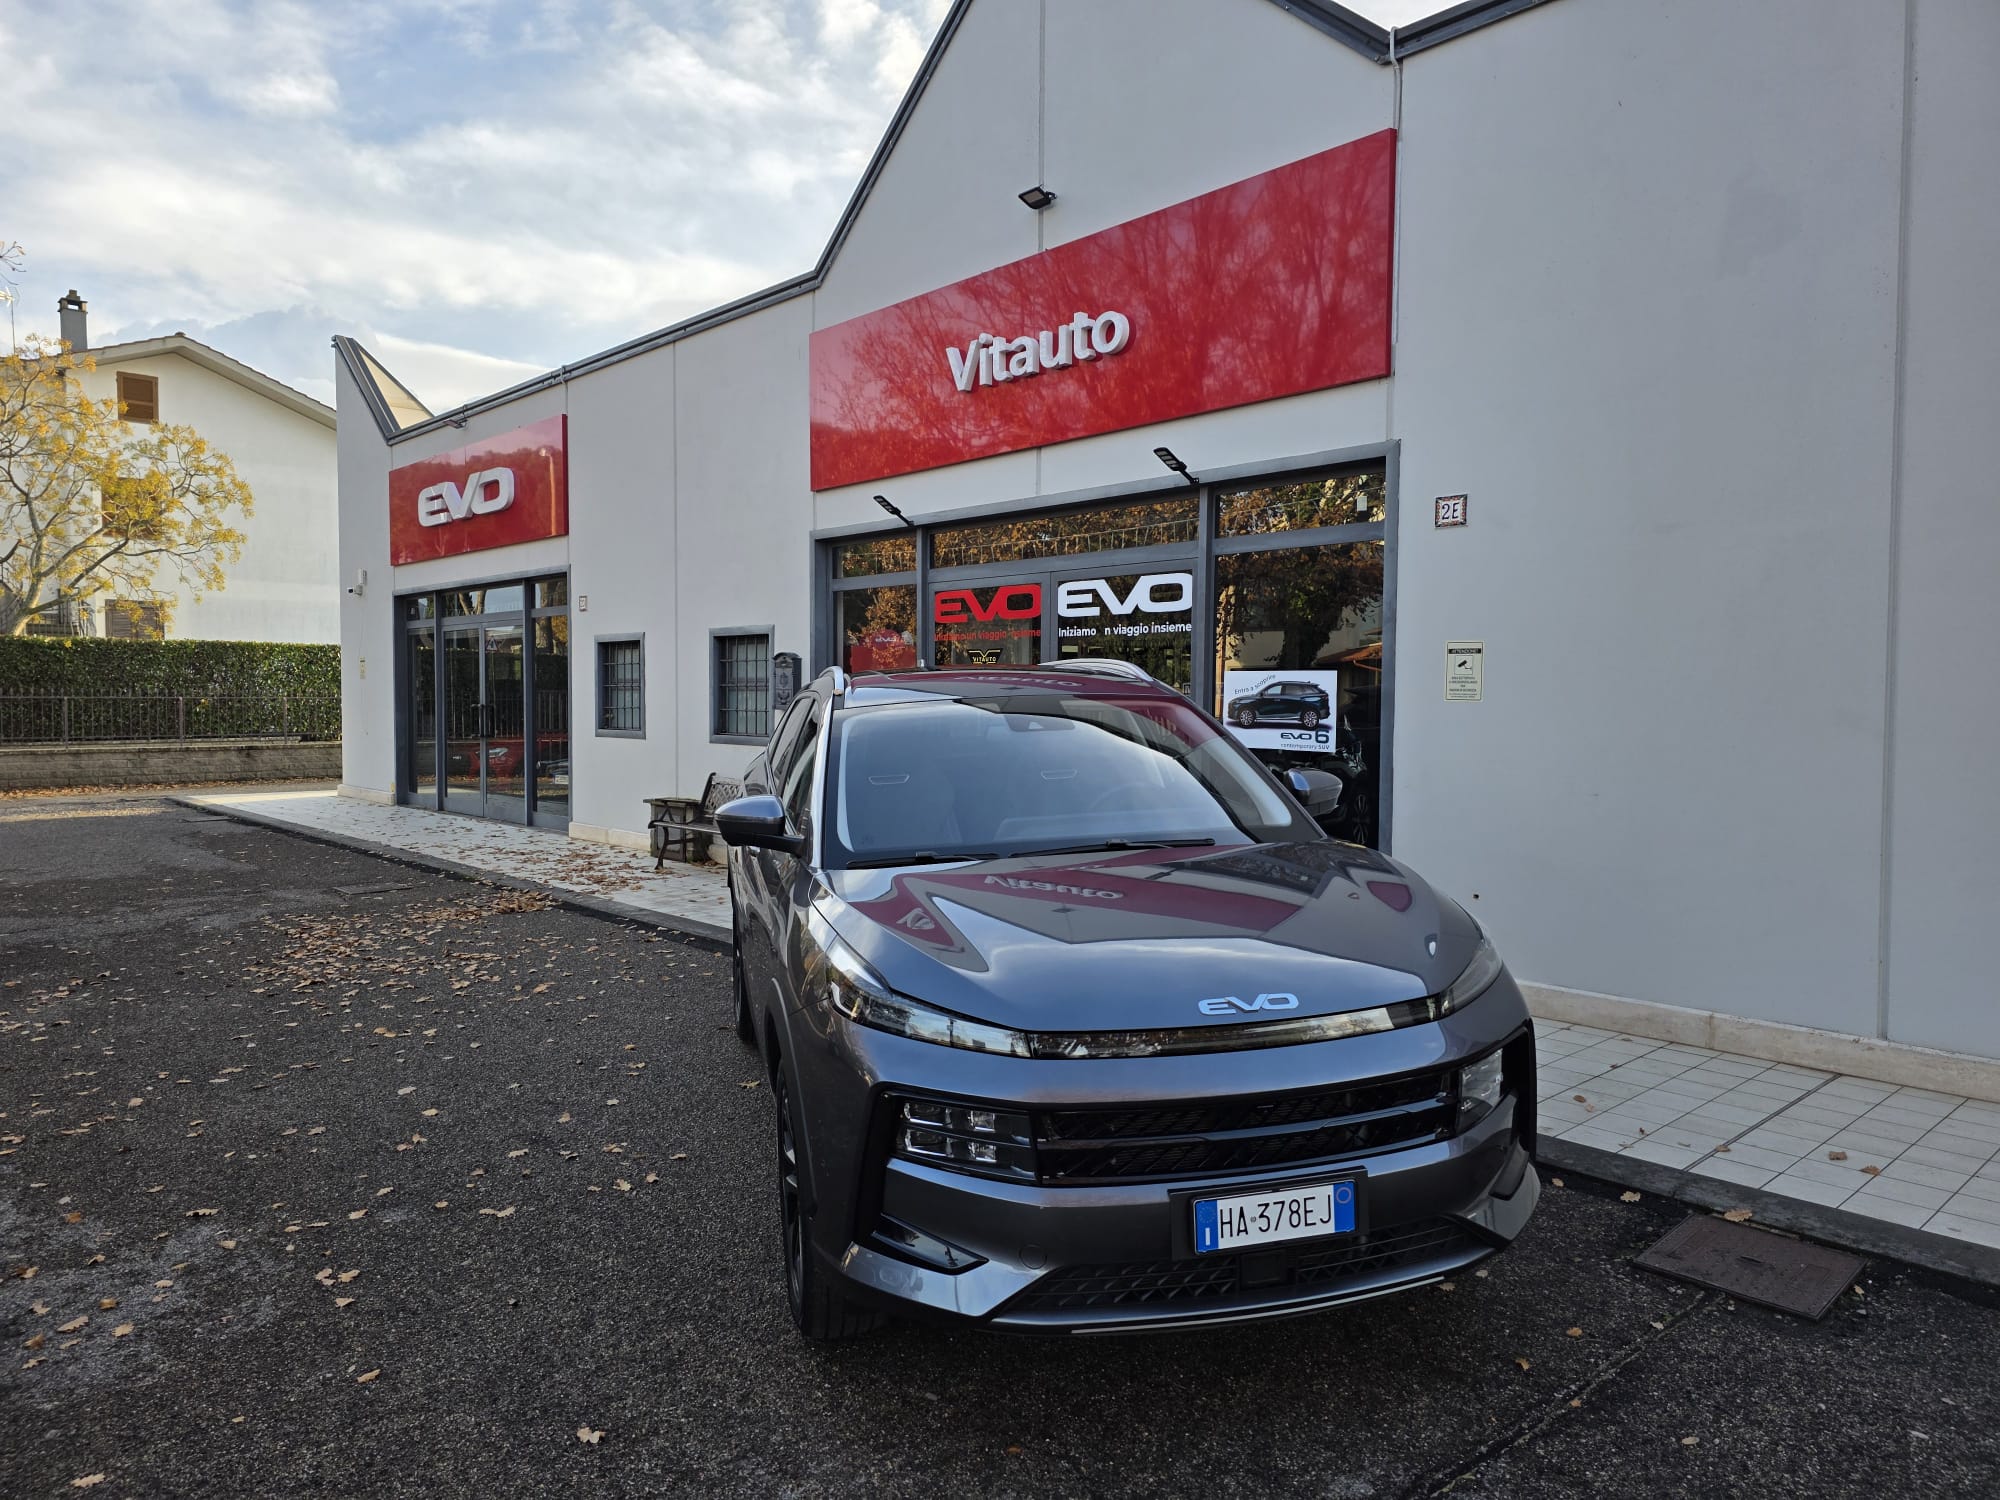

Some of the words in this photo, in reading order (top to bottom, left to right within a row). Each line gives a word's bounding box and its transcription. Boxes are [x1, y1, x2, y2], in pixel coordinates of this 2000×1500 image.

[945, 310, 1130, 392] Vitauto
[418, 466, 515, 527] EVO
[1442, 502, 1459, 520] 2E
[935, 583, 1042, 624] EVO
[1057, 573, 1193, 618] EVO
[1058, 625, 1096, 638] Iniziamo
[1113, 622, 1149, 637] viaggio
[1151, 621, 1193, 634] insieme
[1280, 732, 1313, 741] EVO
[1315, 729, 1330, 745] 6
[1198, 992, 1300, 1016] EVO
